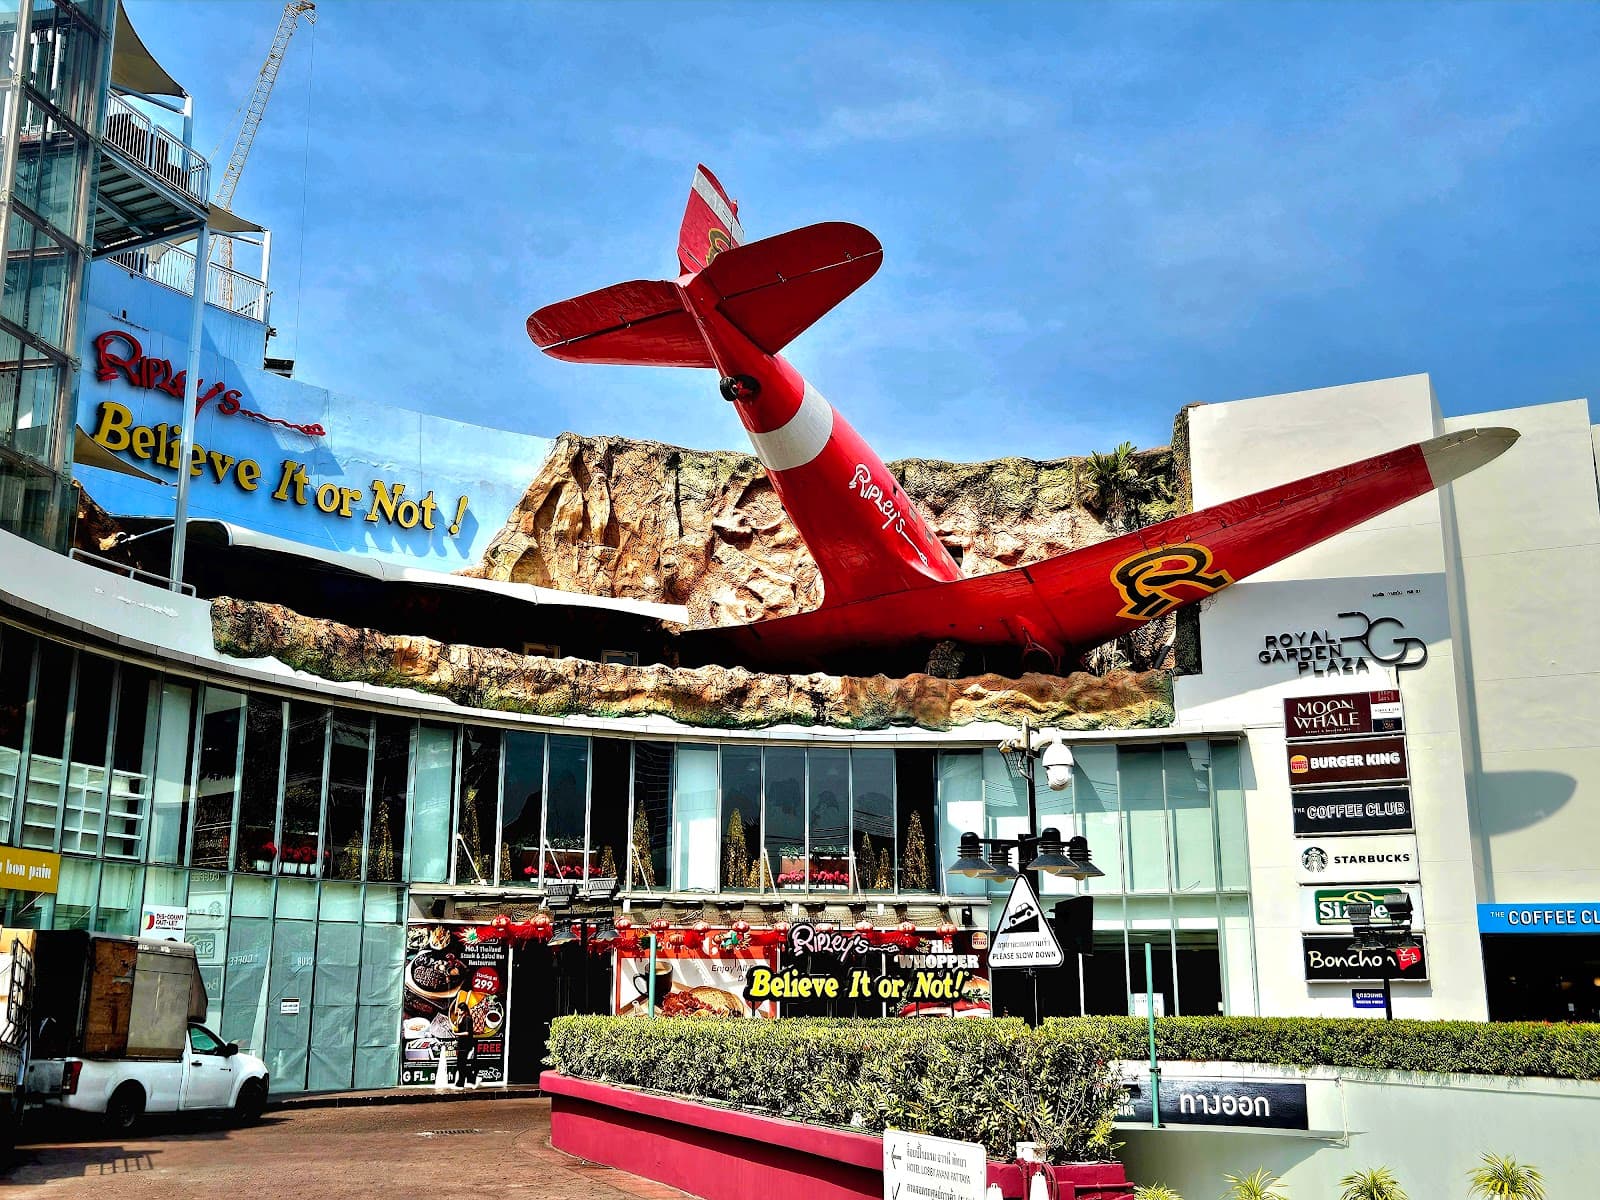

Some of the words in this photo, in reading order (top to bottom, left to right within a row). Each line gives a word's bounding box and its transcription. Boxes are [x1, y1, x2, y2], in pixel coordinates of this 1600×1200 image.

[94, 401, 262, 492] Believe
[273, 459, 310, 505] It
[317, 481, 362, 518] or
[1265, 630, 1336, 650] ROYAL
[1258, 643, 1342, 664] GARDEN
[1297, 657, 1370, 676] PLAZA
[1297, 699, 1354, 716] MOON
[1293, 711, 1361, 729] WHALE
[1310, 754, 1364, 770] BURGER
[1366, 751, 1401, 767] KING
[1306, 803, 1364, 820] COFFEE
[1365, 801, 1406, 817] CLUB
[1334, 853, 1411, 865] STARBUCKS
[28, 863, 52, 881] pain
[1507, 910, 1577, 926] COFFEE
[929, 939, 953, 954] HE
[992, 952, 1014, 960] PLEASE
[1016, 951, 1034, 959] SLOW
[750, 969, 839, 998] Believe
[848, 970, 871, 998] It
[878, 977, 904, 998] or
[913, 971, 966, 998] Not!
[477, 1043, 502, 1053] FREE
[1180, 1092, 1271, 1118] ทางออก
